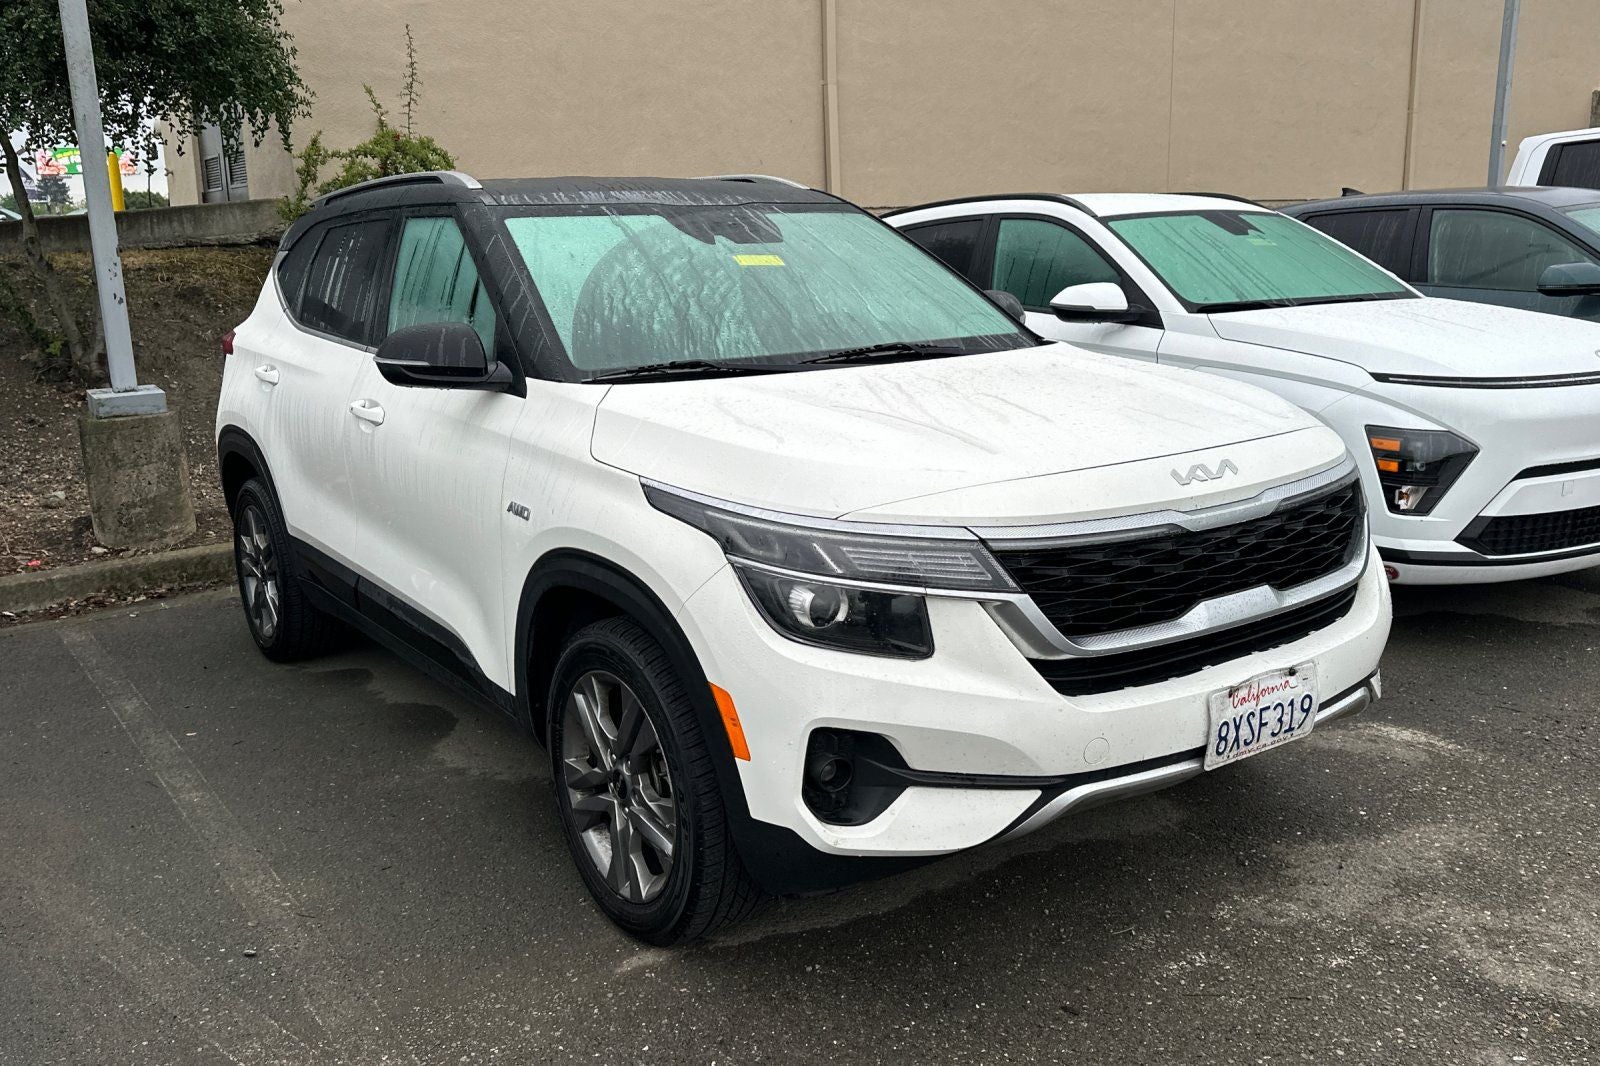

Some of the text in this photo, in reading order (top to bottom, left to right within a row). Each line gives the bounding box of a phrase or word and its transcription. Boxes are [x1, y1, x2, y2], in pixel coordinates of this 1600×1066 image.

[507, 501, 531, 521] AWD
[1230, 679, 1297, 708] California
[1216, 694, 1313, 756] 8XSF319
